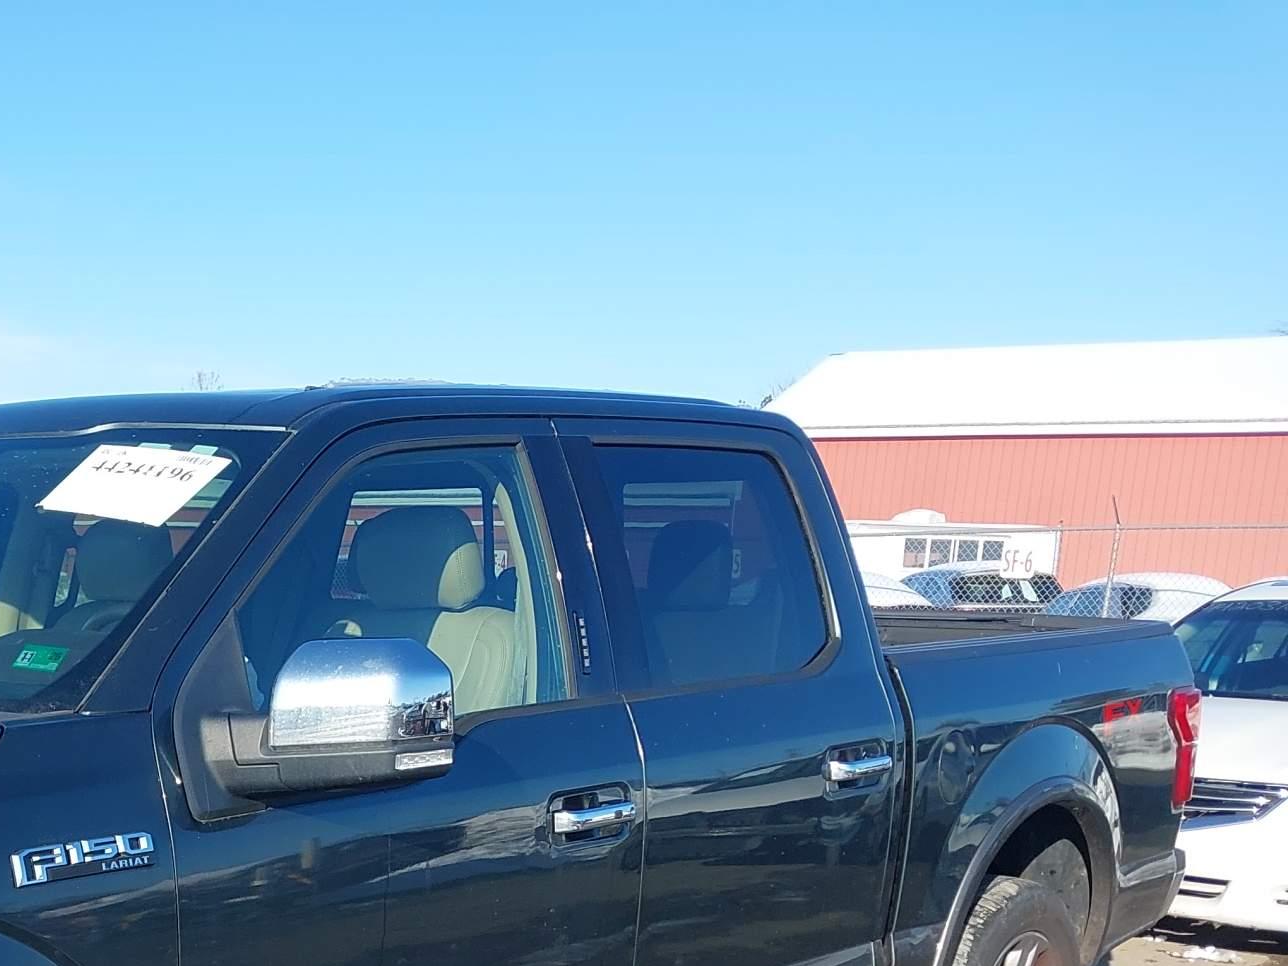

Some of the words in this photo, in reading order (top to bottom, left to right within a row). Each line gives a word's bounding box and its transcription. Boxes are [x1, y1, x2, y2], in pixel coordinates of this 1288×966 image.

[91, 460, 195, 481] 44241196
[1002, 550, 1033, 573] SF-6
[102, 855, 150, 871] LARIAT
